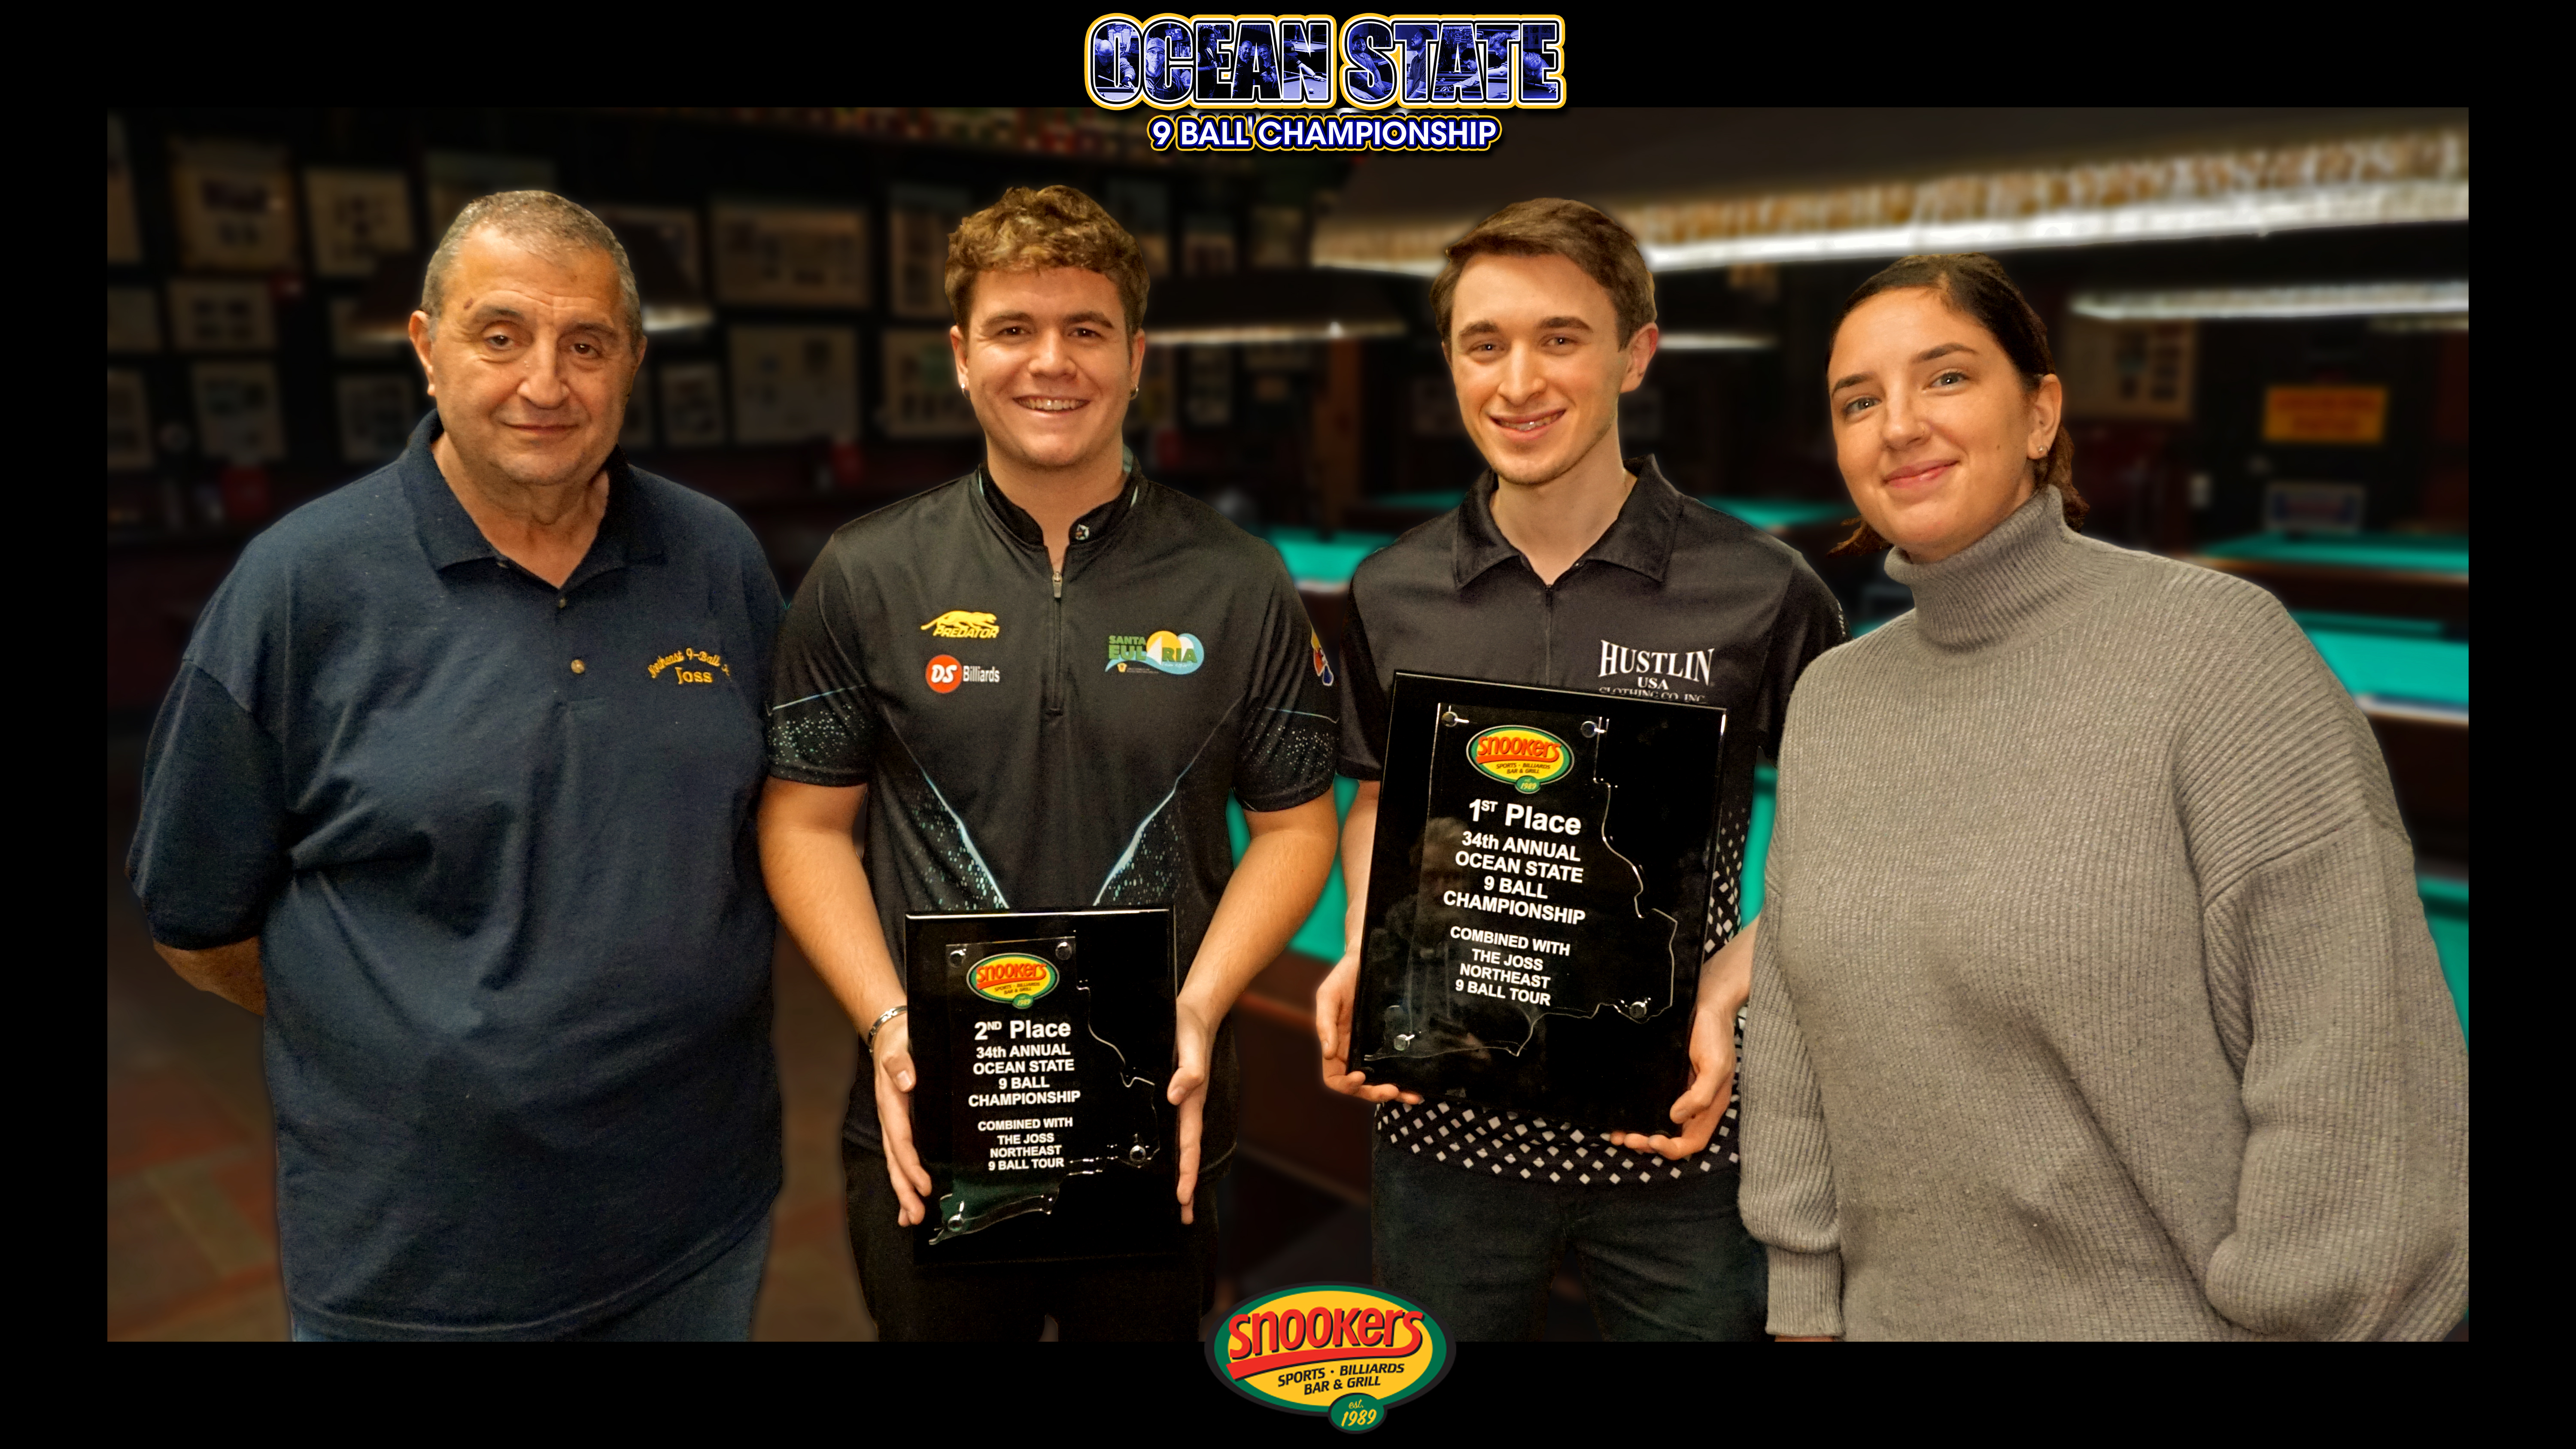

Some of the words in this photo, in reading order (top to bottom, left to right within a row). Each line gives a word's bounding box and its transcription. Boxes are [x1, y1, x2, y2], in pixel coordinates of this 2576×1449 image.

[933, 627, 999, 638] PREDATOR
[1109, 635, 1146, 645] SANTA
[685, 648, 721, 667] 9-Ball
[1598, 639, 1715, 686] HUSTLIN
[674, 667, 714, 685] Joss
[931, 664, 957, 683] DS
[963, 666, 1000, 683] Billiards
[1637, 676, 1669, 690] USA
[1469, 799, 1498, 822] 1ST
[1505, 803, 1582, 835] Place
[1462, 831, 1499, 850] 34th
[1503, 837, 1581, 862] ANNUAL
[1455, 851, 1521, 874] OCEAN
[1525, 861, 1584, 883] STATE
[1484, 876, 1495, 891] 9
[1499, 878, 1548, 899] BALL
[1443, 891, 1586, 925] CHAMPIONSHIP
[1450, 926, 1529, 949] COMBINED
[1533, 939, 1571, 956] WITH
[1472, 949, 1501, 964] THE
[1504, 955, 1543, 971] JOSS
[1460, 964, 1551, 989] NORTHEAST
[1455, 979, 1464, 991] 9
[1467, 981, 1506, 998] BALL
[1510, 988, 1551, 1006] TOUR
[974, 1021, 1002, 1040] 2ND
[1010, 1020, 1071, 1039] Place
[976, 1046, 1007, 1059] 34th
[1009, 1043, 1071, 1058] ANNUAL
[973, 1061, 1026, 1075] OCEAN
[1029, 1059, 1075, 1073] STATE
[998, 1078, 1008, 1090] 9
[1011, 1076, 1050, 1089] BALL
[968, 1090, 1081, 1107] CHAMPIONSHIP
[978, 1119, 1041, 1131] COMBINED
[1043, 1117, 1073, 1129] WITH
[996, 1134, 1021, 1146] THE
[1023, 1133, 1054, 1144] JOSS
[990, 1145, 1062, 1158] NORTHEAST
[988, 1161, 996, 1171] 9
[998, 1159, 1029, 1171] BALL
[1031, 1158, 1065, 1169] TOUR
